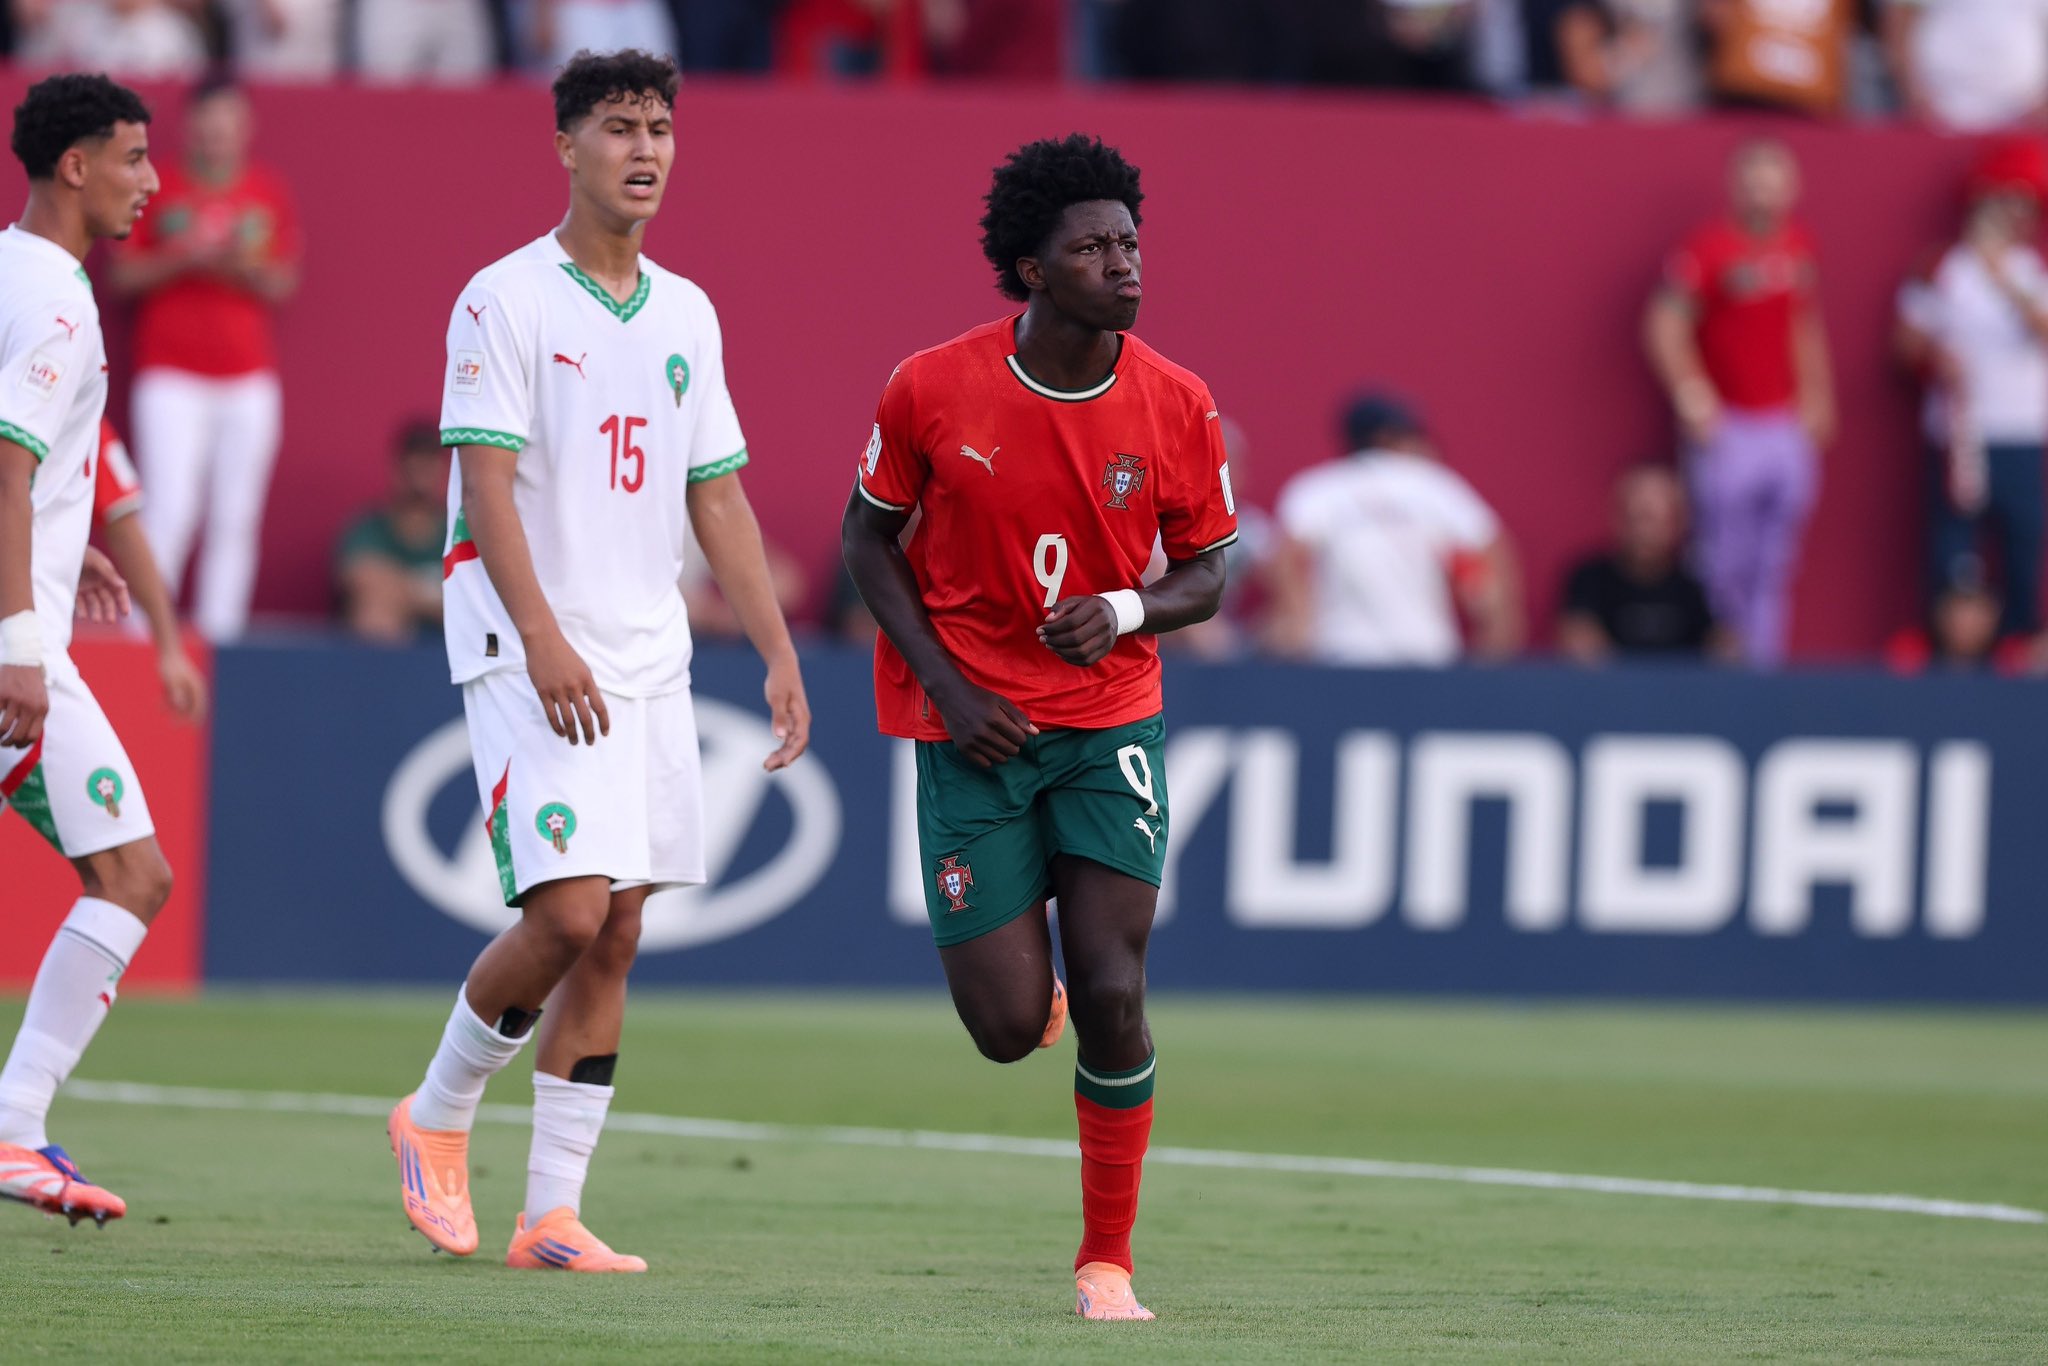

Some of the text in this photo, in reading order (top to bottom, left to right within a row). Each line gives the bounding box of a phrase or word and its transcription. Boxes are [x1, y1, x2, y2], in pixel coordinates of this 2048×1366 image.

[599, 414, 648, 494] 15
[1033, 533, 1069, 608] 9
[1117, 744, 1158, 816] 9
